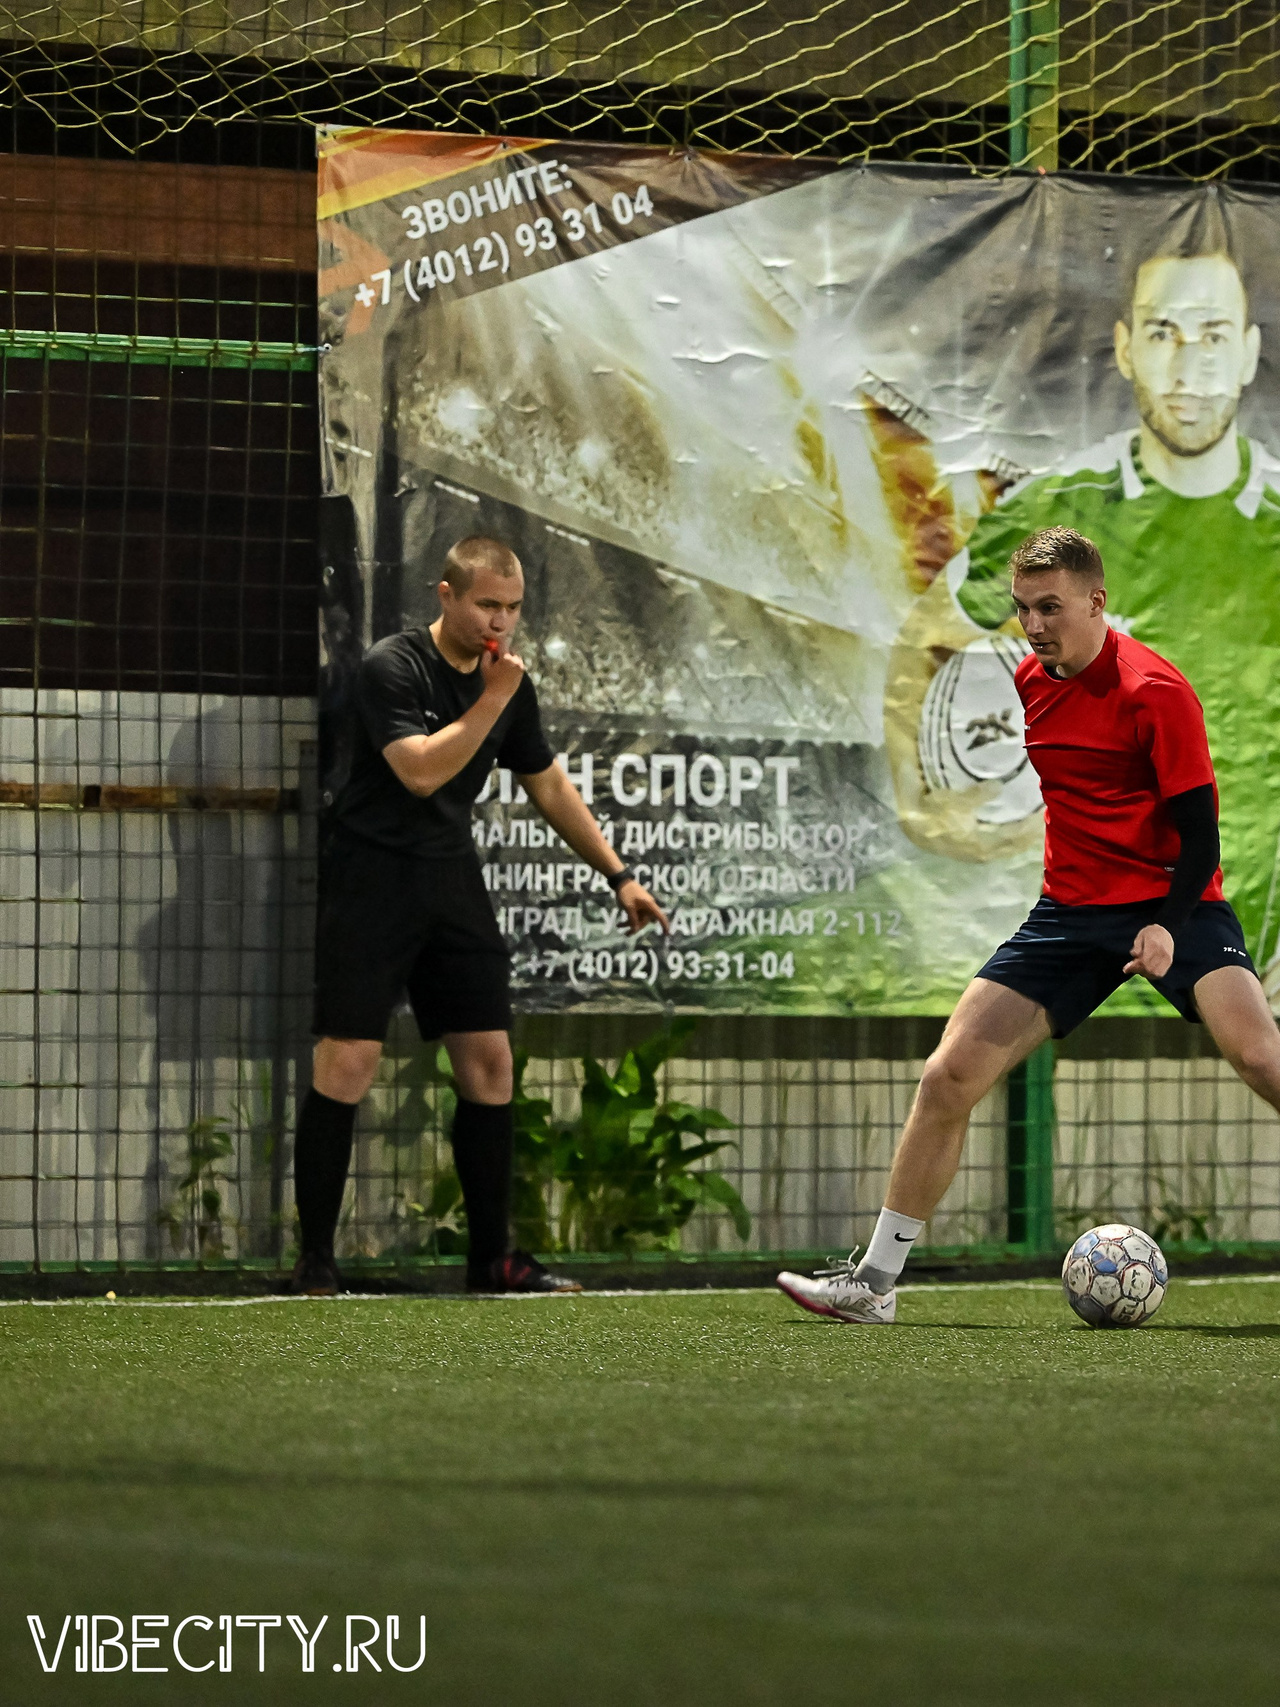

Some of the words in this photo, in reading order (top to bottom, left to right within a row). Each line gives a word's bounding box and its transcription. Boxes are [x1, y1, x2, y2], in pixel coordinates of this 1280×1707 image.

[401, 159, 573, 240] ЗВОНИТЕ:
[354, 269, 393, 308] +7
[402, 230, 511, 303] (4012)
[515, 217, 558, 257] 93
[562, 203, 602, 243] 31
[612, 185, 655, 223] 04
[474, 752, 594, 806] ЛН
[610, 753, 802, 808] СПОРТ
[471, 812, 615, 848] ИАЛЬНЙ
[621, 819, 864, 856] ДИСТРИБЬЮТОР
[481, 858, 711, 899] НИНГРАСКОЙ
[718, 864, 856, 894] ОБЛАСТИ
[822, 908, 902, 937] 2-112
[522, 951, 560, 978] +7
[568, 950, 659, 986] (4012)
[666, 951, 796, 980] 93-31-04
